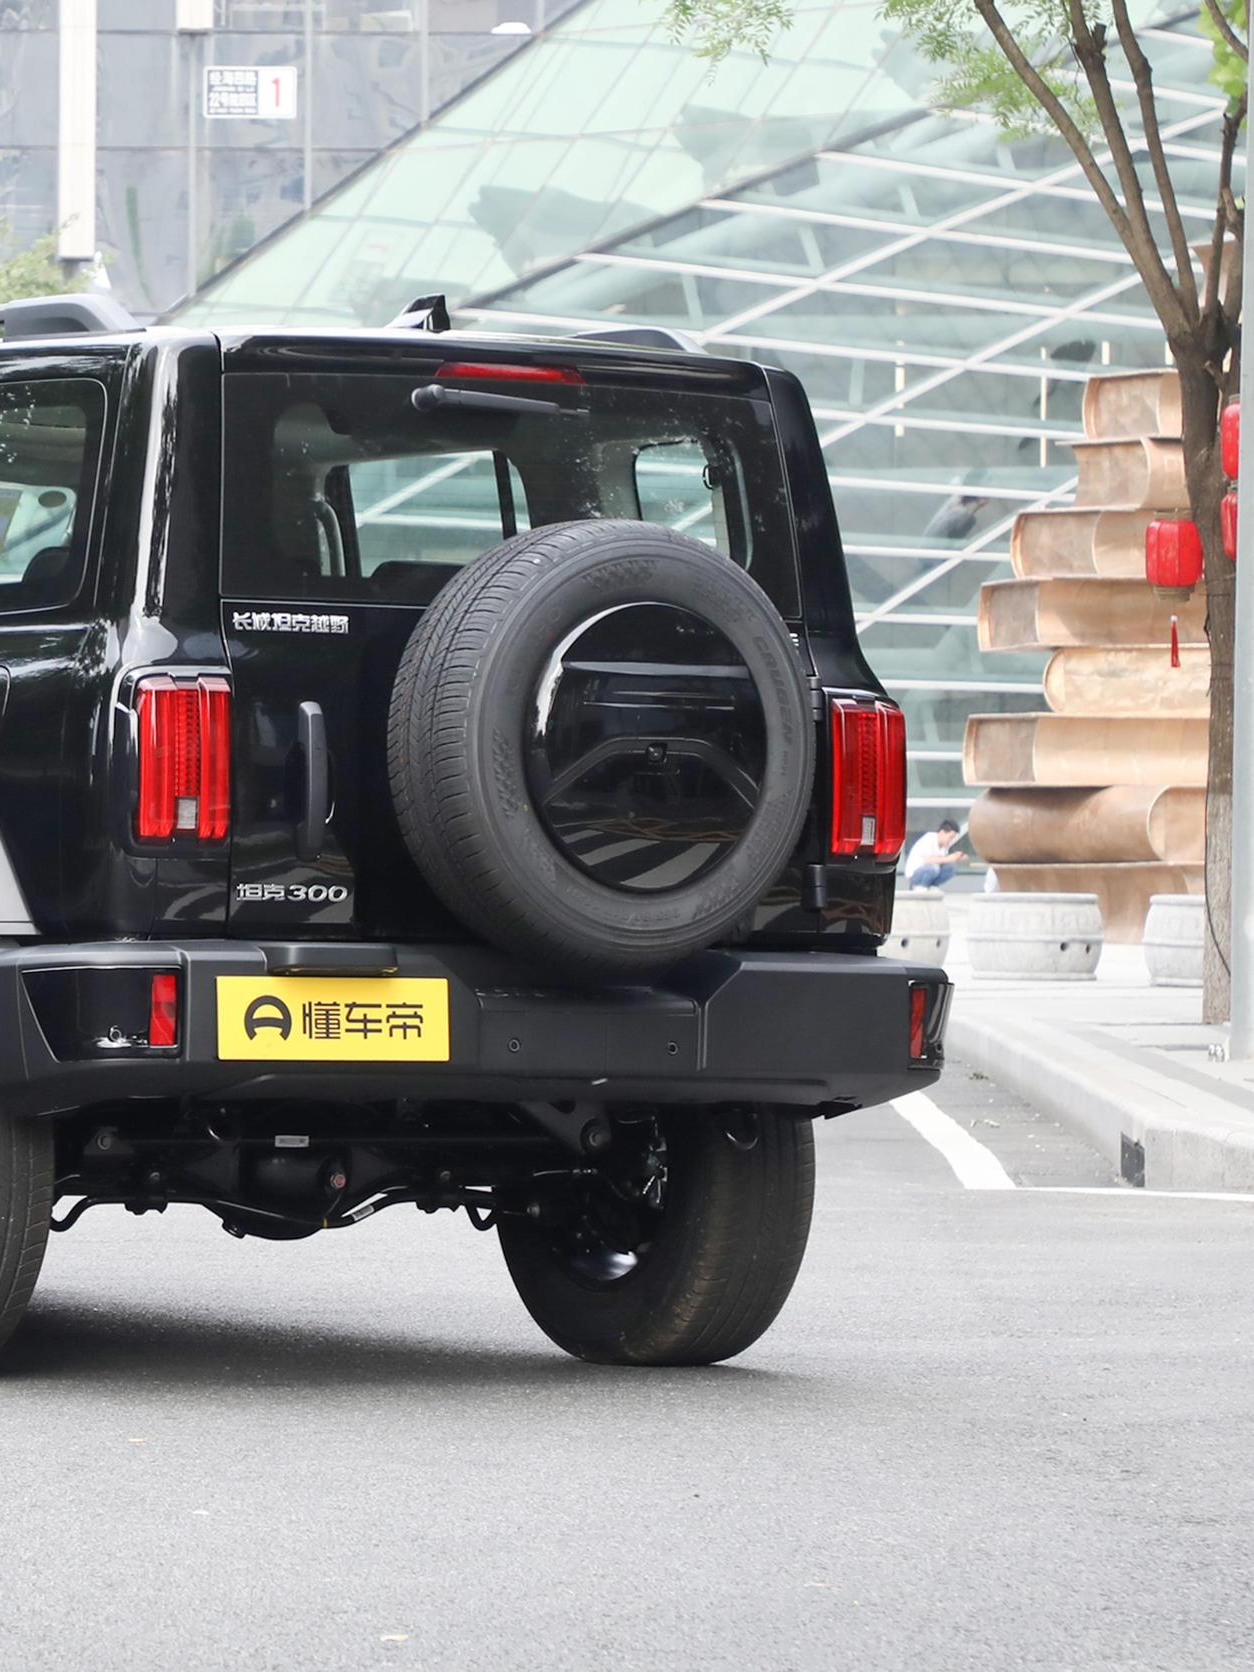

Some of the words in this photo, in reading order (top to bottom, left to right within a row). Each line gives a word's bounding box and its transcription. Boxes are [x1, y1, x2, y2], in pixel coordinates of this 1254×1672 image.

[271, 77, 281, 107] 1
[232, 612, 350, 634] 长城坦克越野
[302, 1000, 424, 1040] 懂车帝
